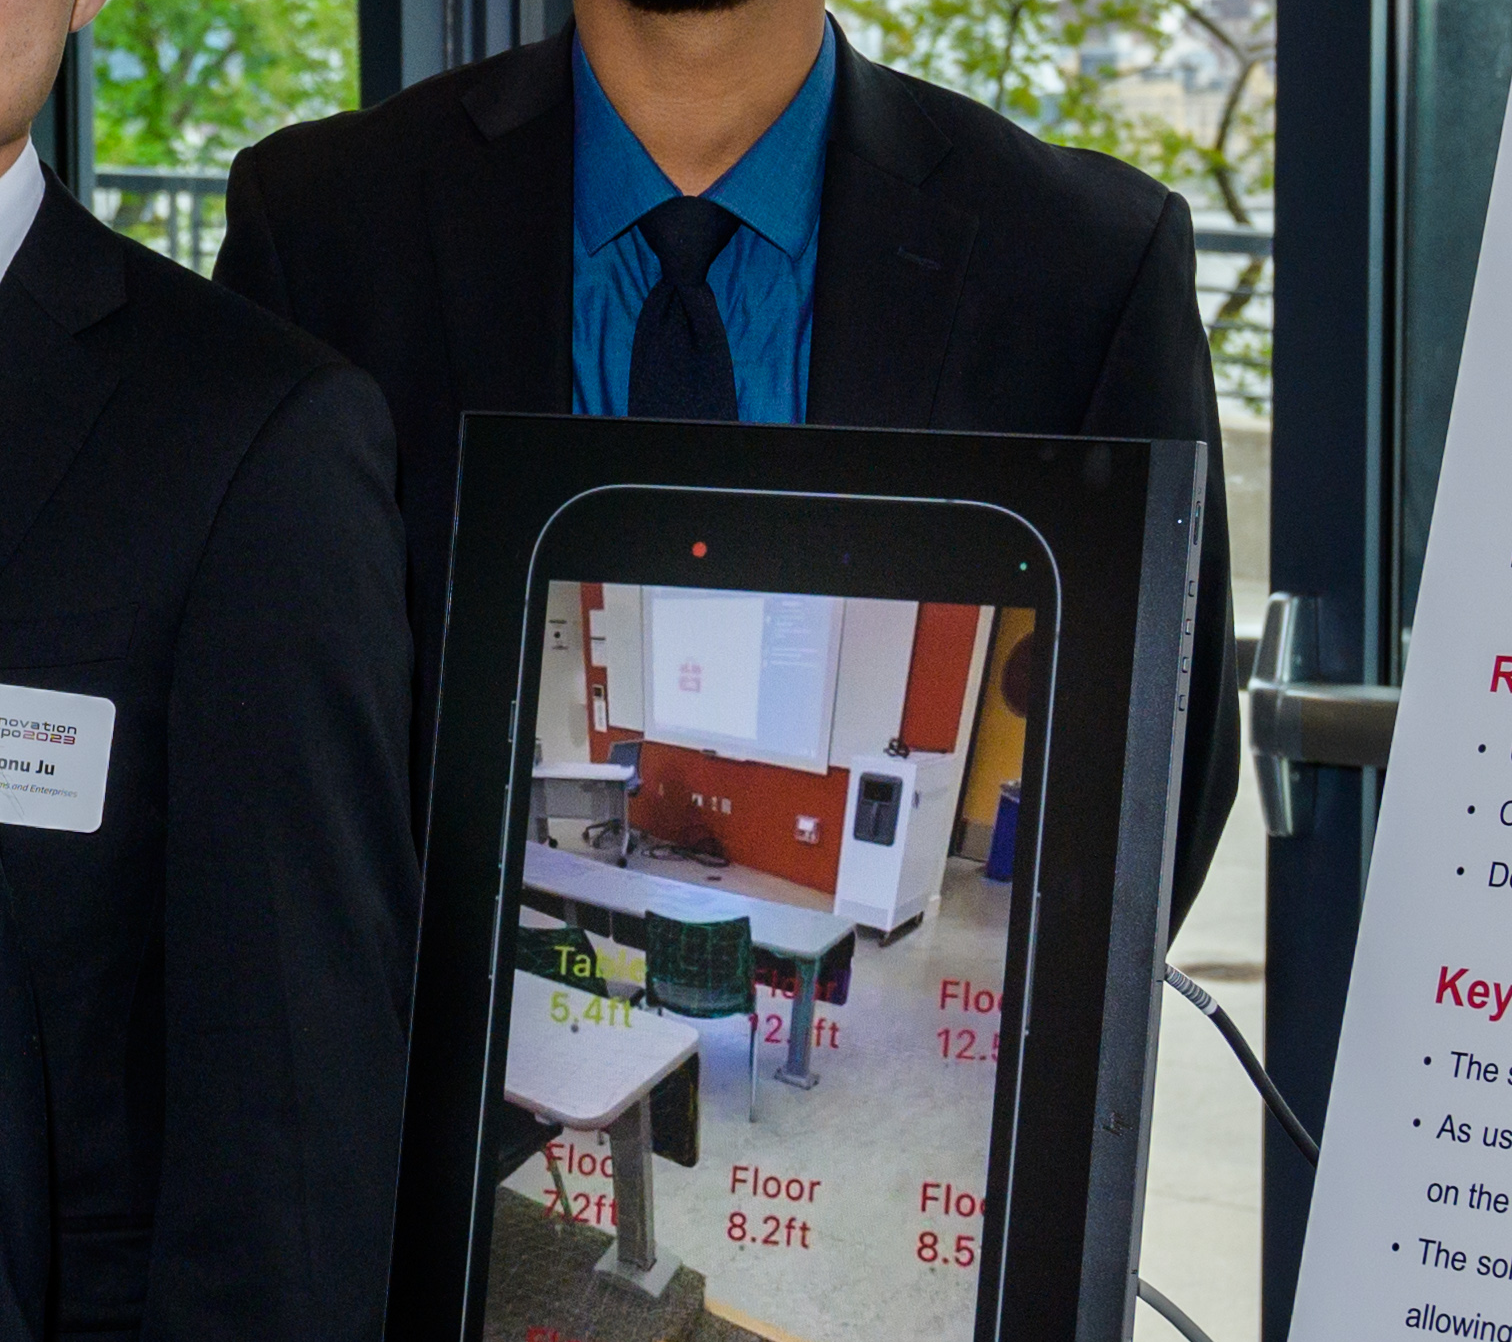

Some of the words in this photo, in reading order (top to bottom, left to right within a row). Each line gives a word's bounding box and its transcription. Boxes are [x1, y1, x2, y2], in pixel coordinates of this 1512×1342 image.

[35, 760, 56, 776] Ju
[549, 992, 634, 1029] 5.4ft
[1435, 1113, 1472, 1144] As
[729, 1165, 821, 1203] Floor
[727, 1212, 812, 1250] 8.2ft
